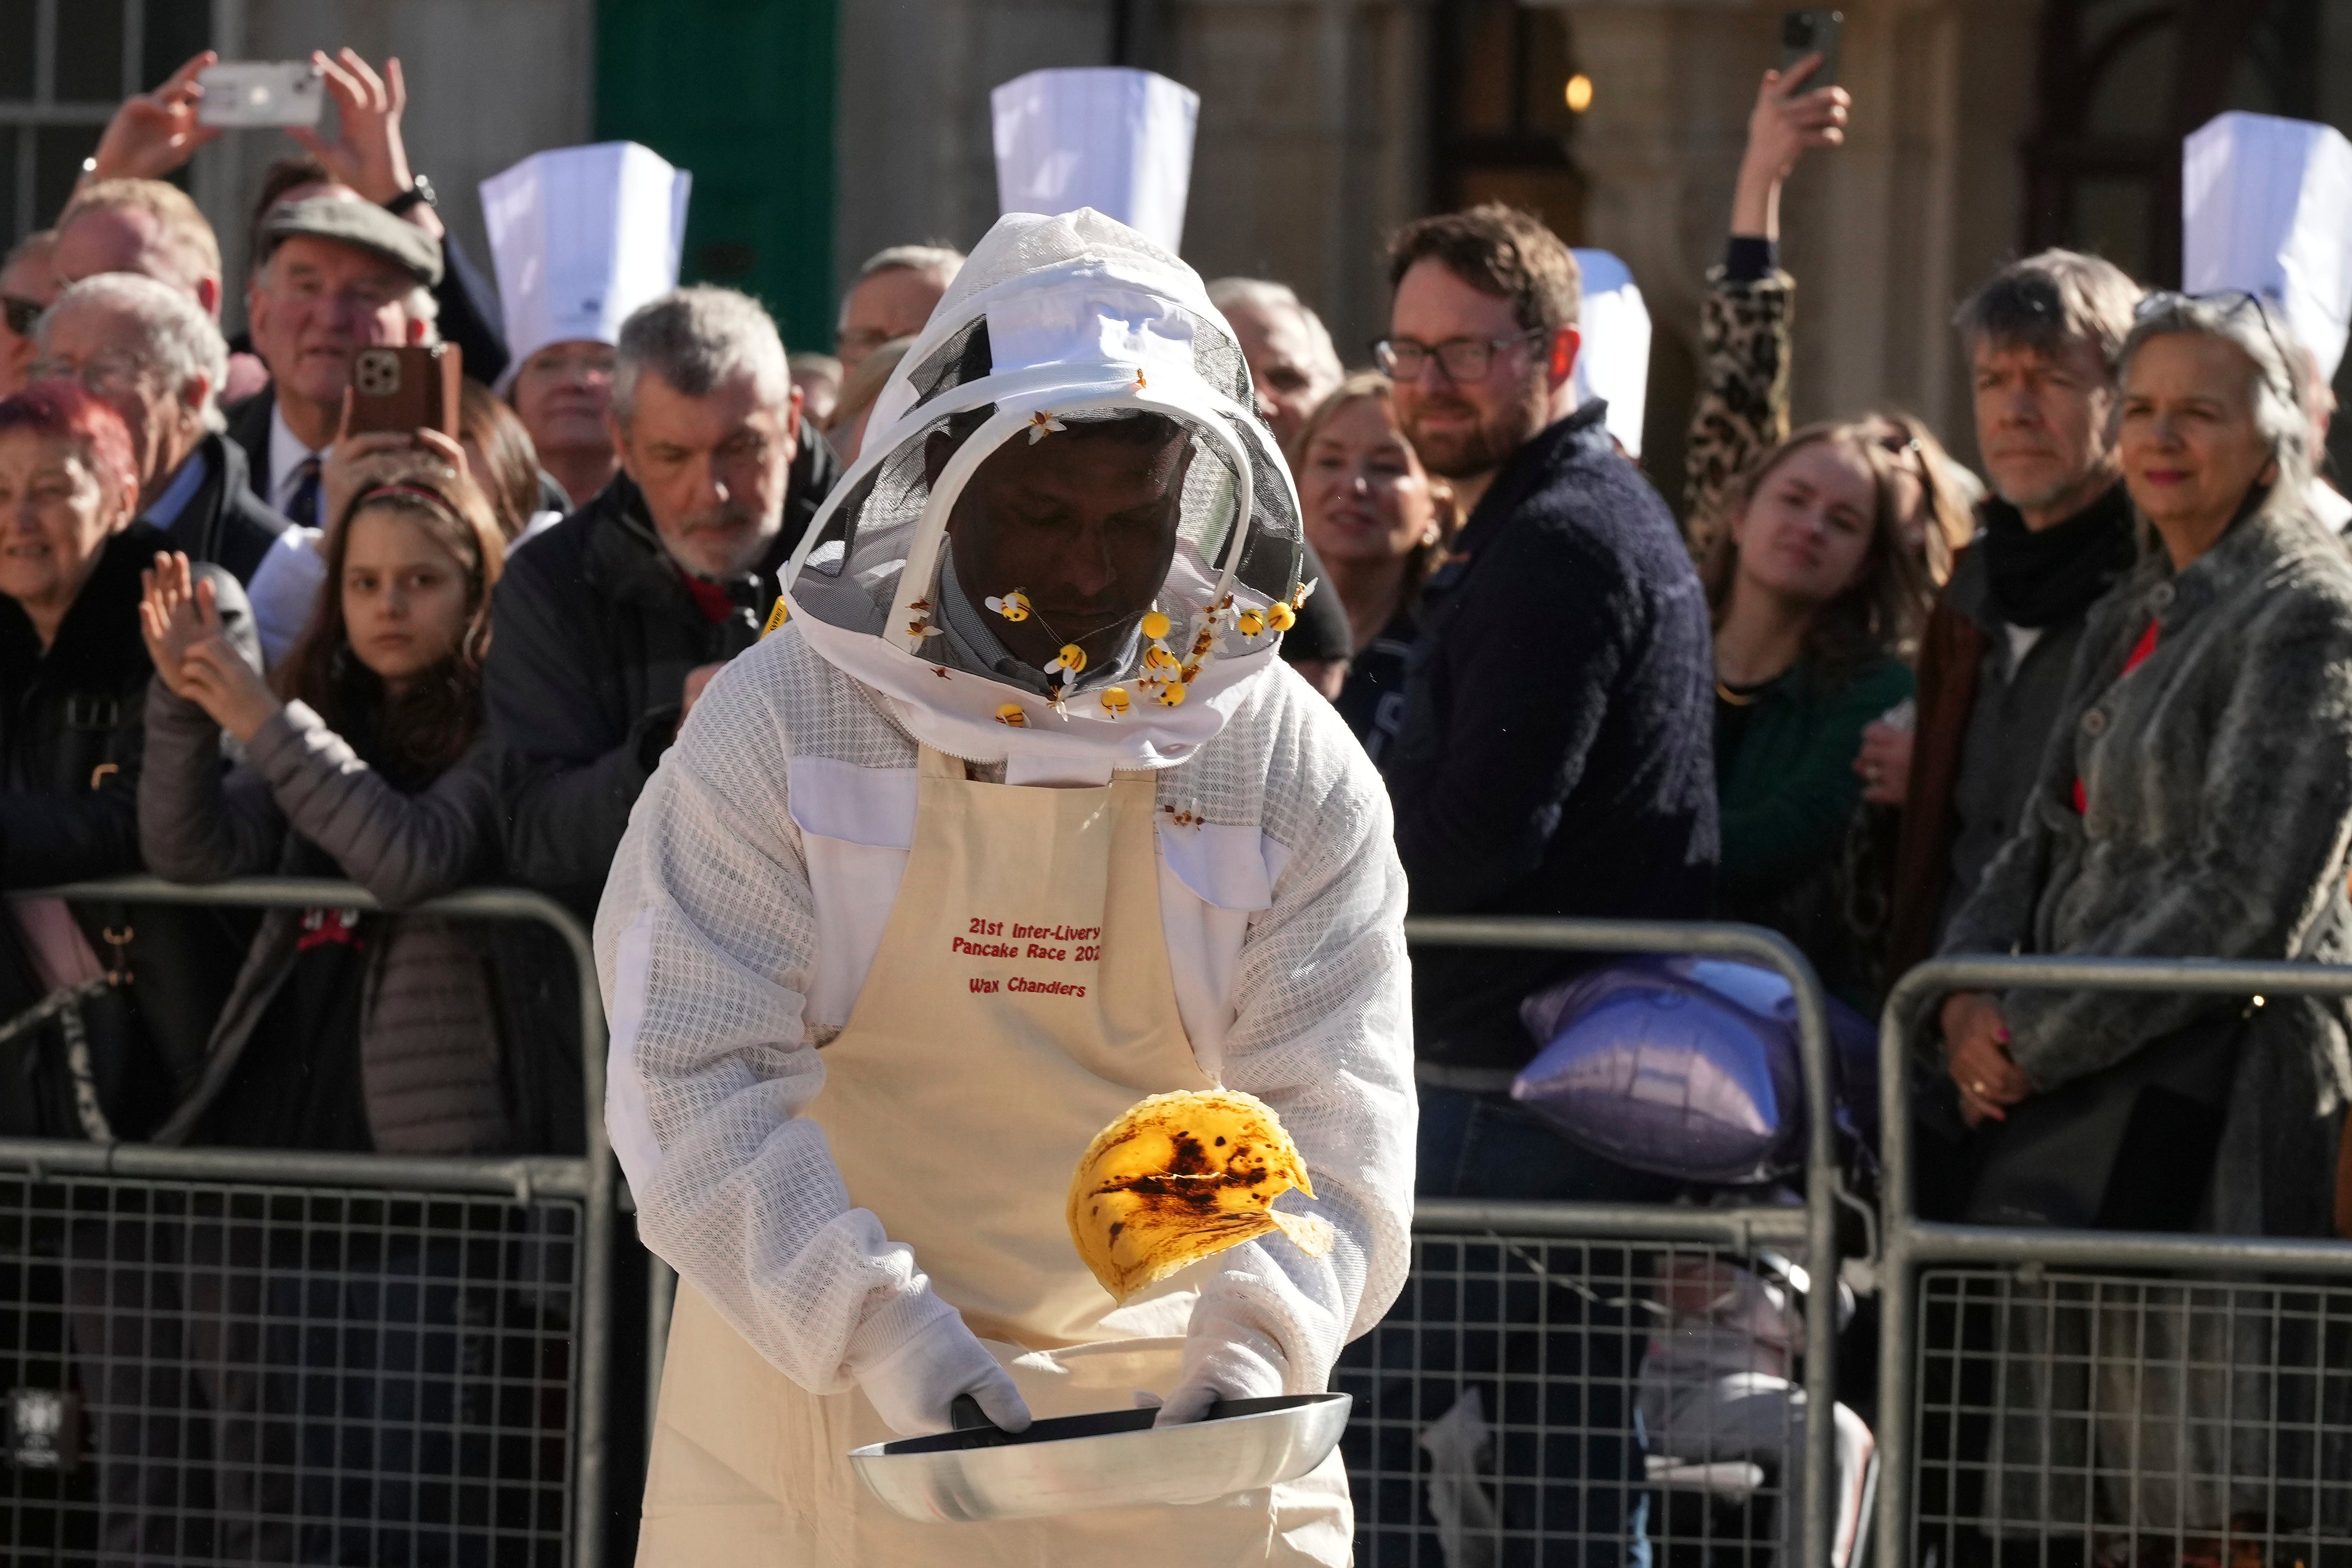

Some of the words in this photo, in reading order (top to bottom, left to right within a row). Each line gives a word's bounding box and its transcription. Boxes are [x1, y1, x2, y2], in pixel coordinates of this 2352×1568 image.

[969, 918, 1004, 937] 21st
[1012, 923, 1101, 941] Inter-Livery
[952, 937, 1019, 958] Pancake
[1027, 944, 1066, 961] Race
[969, 978, 1000, 994] Wax
[1007, 977, 1086, 998] Chandlers
